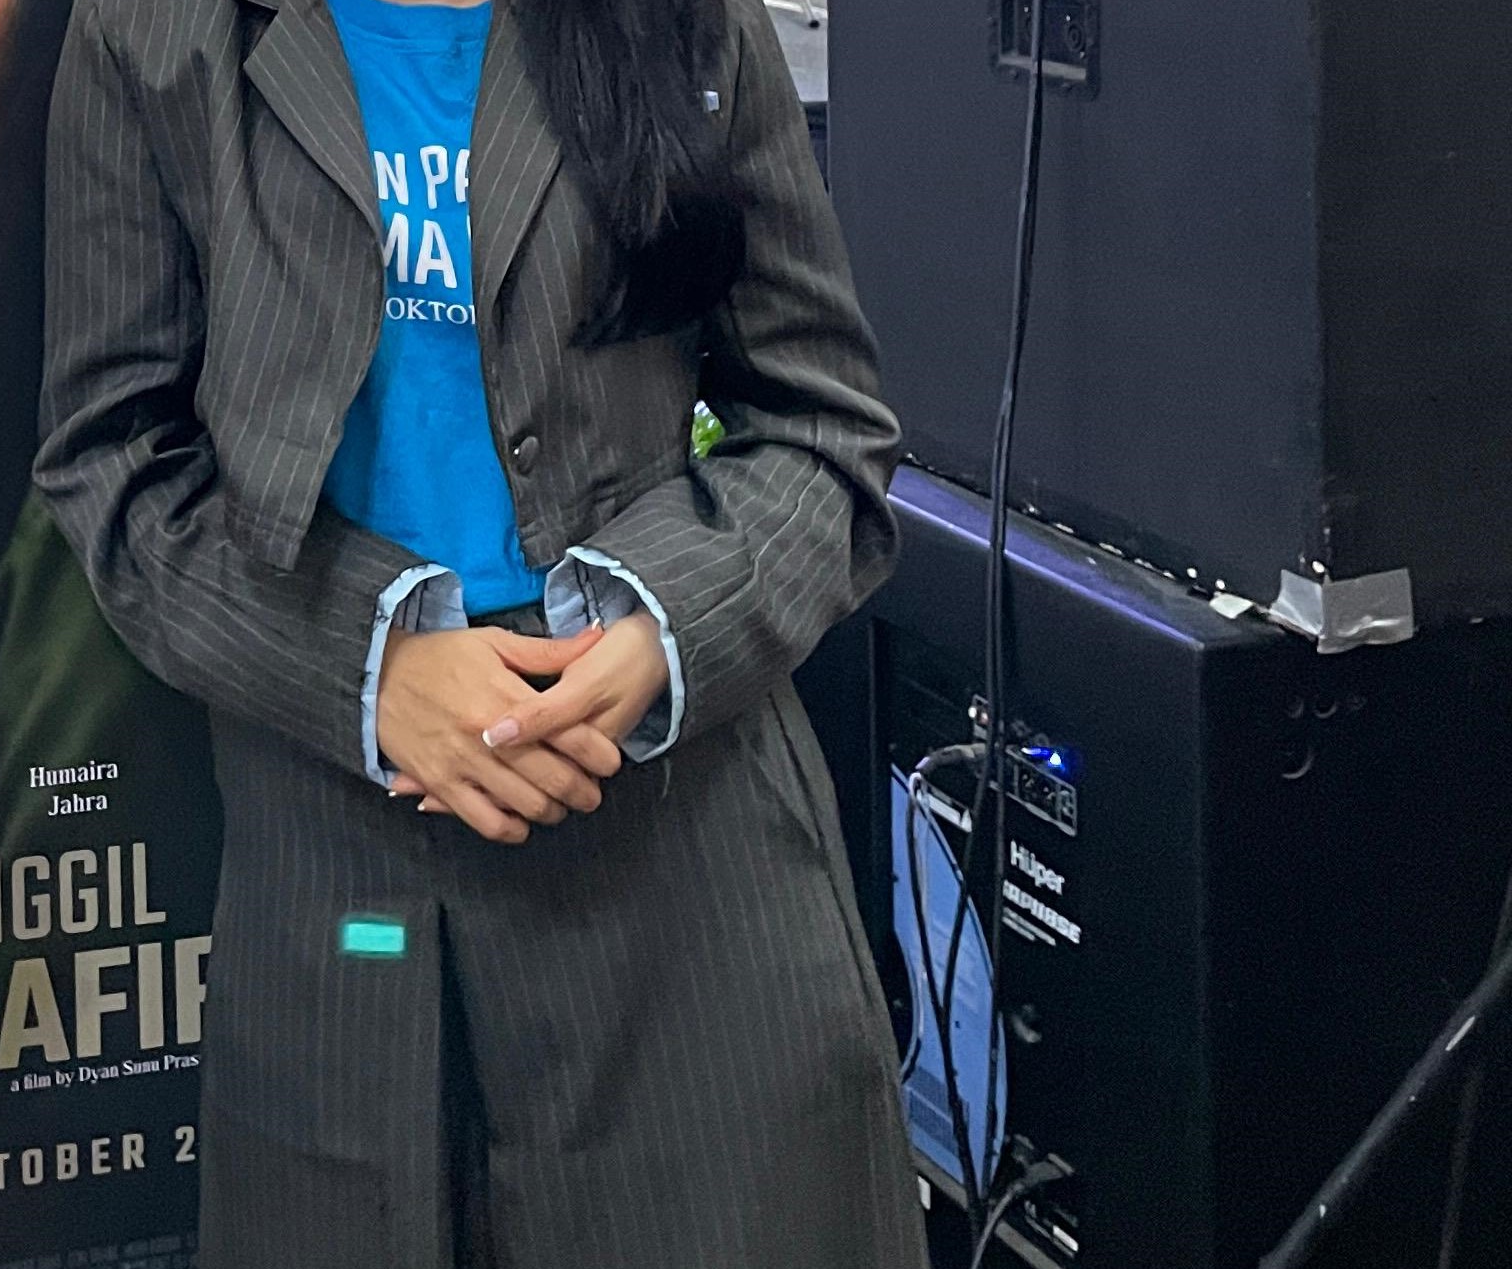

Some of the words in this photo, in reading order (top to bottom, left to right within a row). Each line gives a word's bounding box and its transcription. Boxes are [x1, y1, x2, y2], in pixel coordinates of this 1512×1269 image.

[29, 761, 119, 789] Humaira
[48, 792, 108, 816] Jahra
[10, 1078, 19, 1092] a
[23, 1073, 51, 1090] film
[55, 1070, 74, 1088] by
[79, 1065, 119, 1084] Dyan
